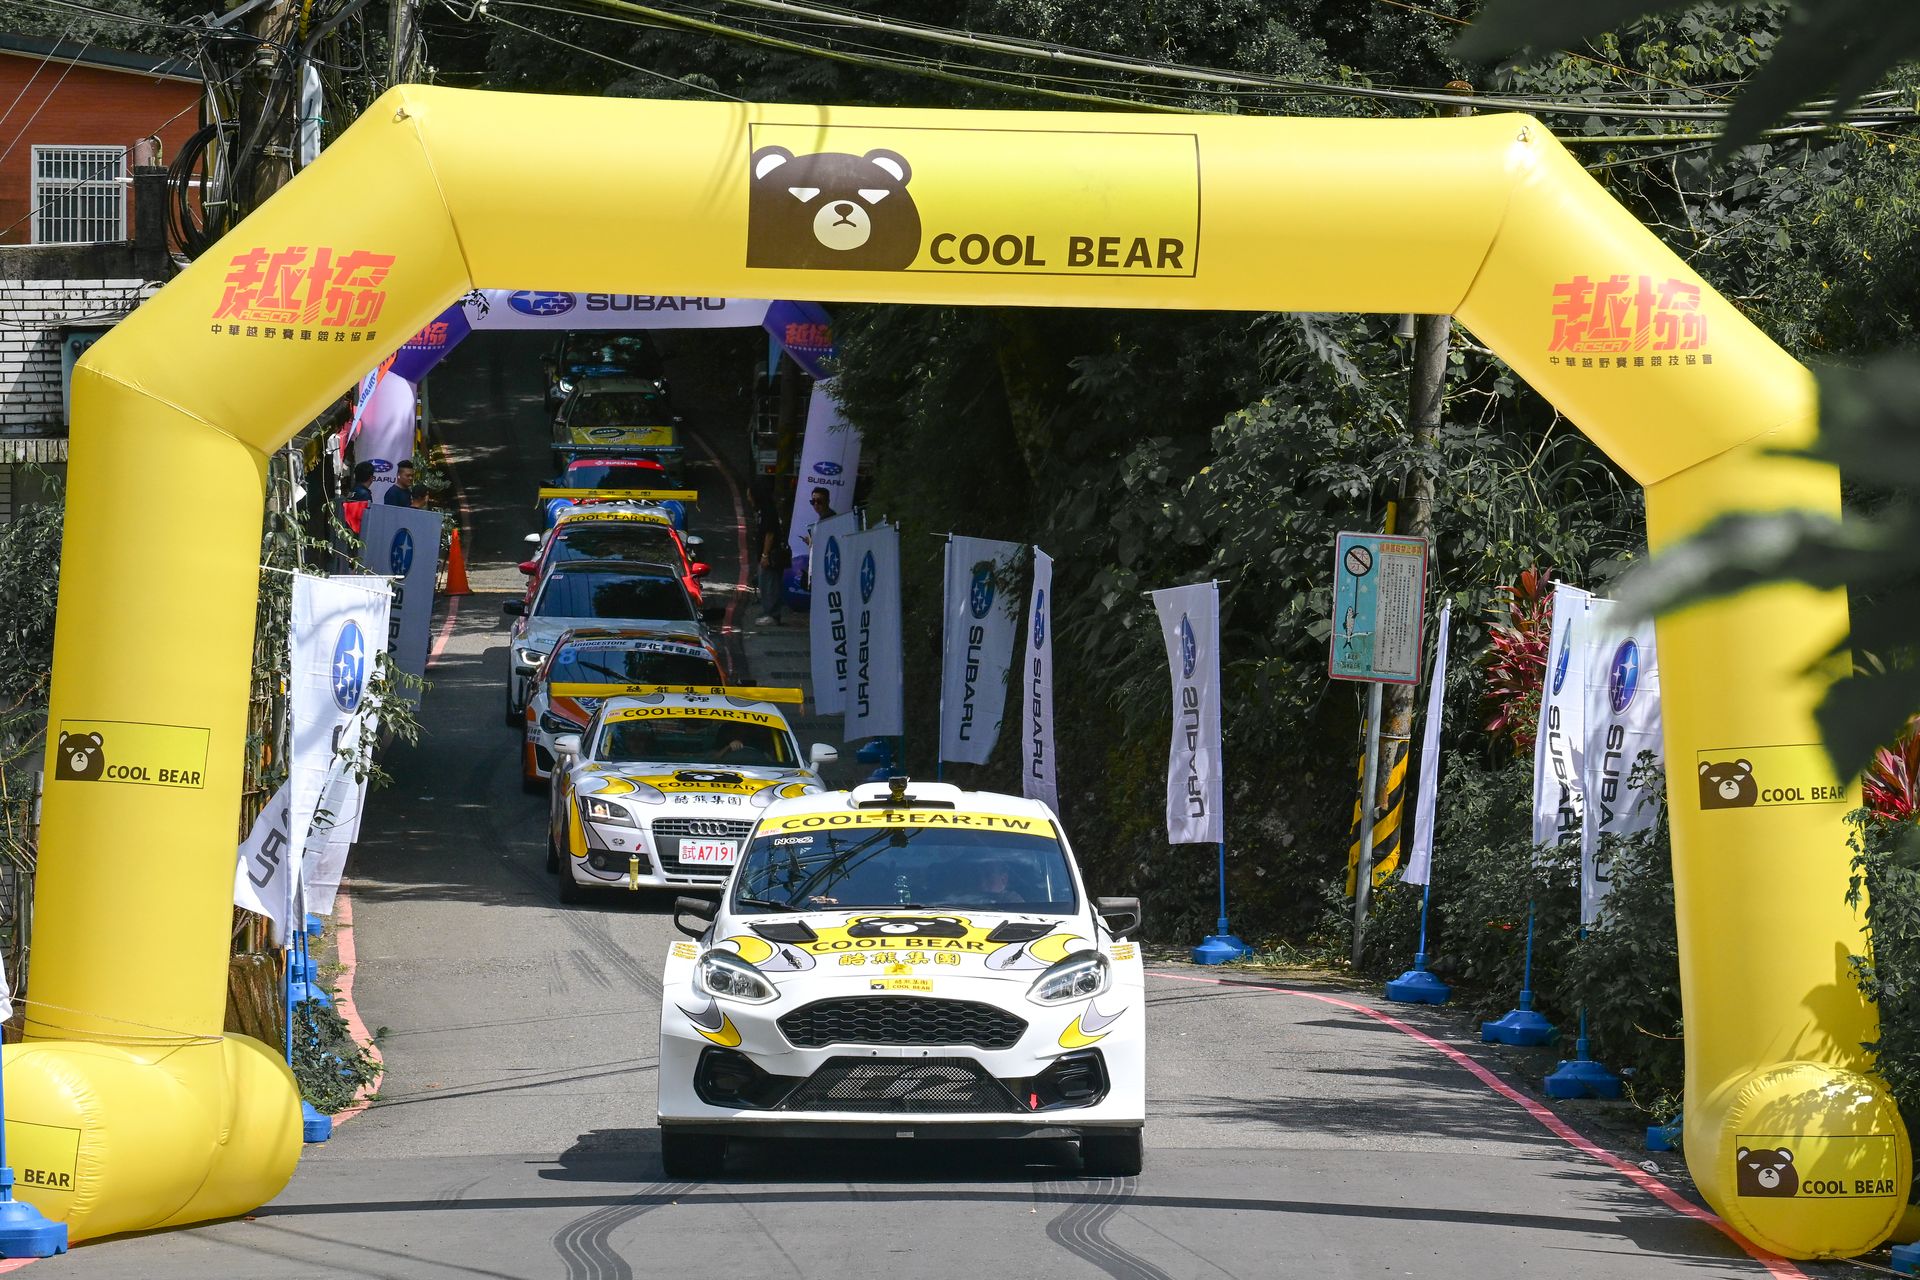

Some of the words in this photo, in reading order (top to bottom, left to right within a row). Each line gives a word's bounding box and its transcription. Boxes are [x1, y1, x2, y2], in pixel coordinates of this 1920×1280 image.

[930, 232, 1046, 267] COOL
[1067, 236, 1185, 270] BEAR
[212, 247, 396, 328] 越協
[586, 293, 726, 311] SUBARU
[240, 310, 293, 322] ACSCA
[1548, 275, 1707, 352] 越協
[372, 475, 396, 484] BARU
[808, 476, 845, 486] SUBARU
[959, 625, 983, 741] SUBARU
[623, 708, 769, 723] COOL-BEAR.TW
[1032, 657, 1044, 779] SUBARU
[107, 765, 150, 781] COOL
[158, 769, 200, 785] BEAR
[711, 782, 756, 791] BEAR
[1762, 788, 1804, 802] COOL
[1811, 786, 1845, 800] BEAR
[782, 813, 1031, 830] COOL-BEAR.TW
[812, 938, 895, 951] COOL
[906, 938, 984, 950] BEAR
[839, 951, 961, 966] 酷熊集團
[24, 1169, 70, 1188] BEAR
[1802, 1180, 1847, 1194] COOL
[1855, 1180, 1894, 1194] BEAR
